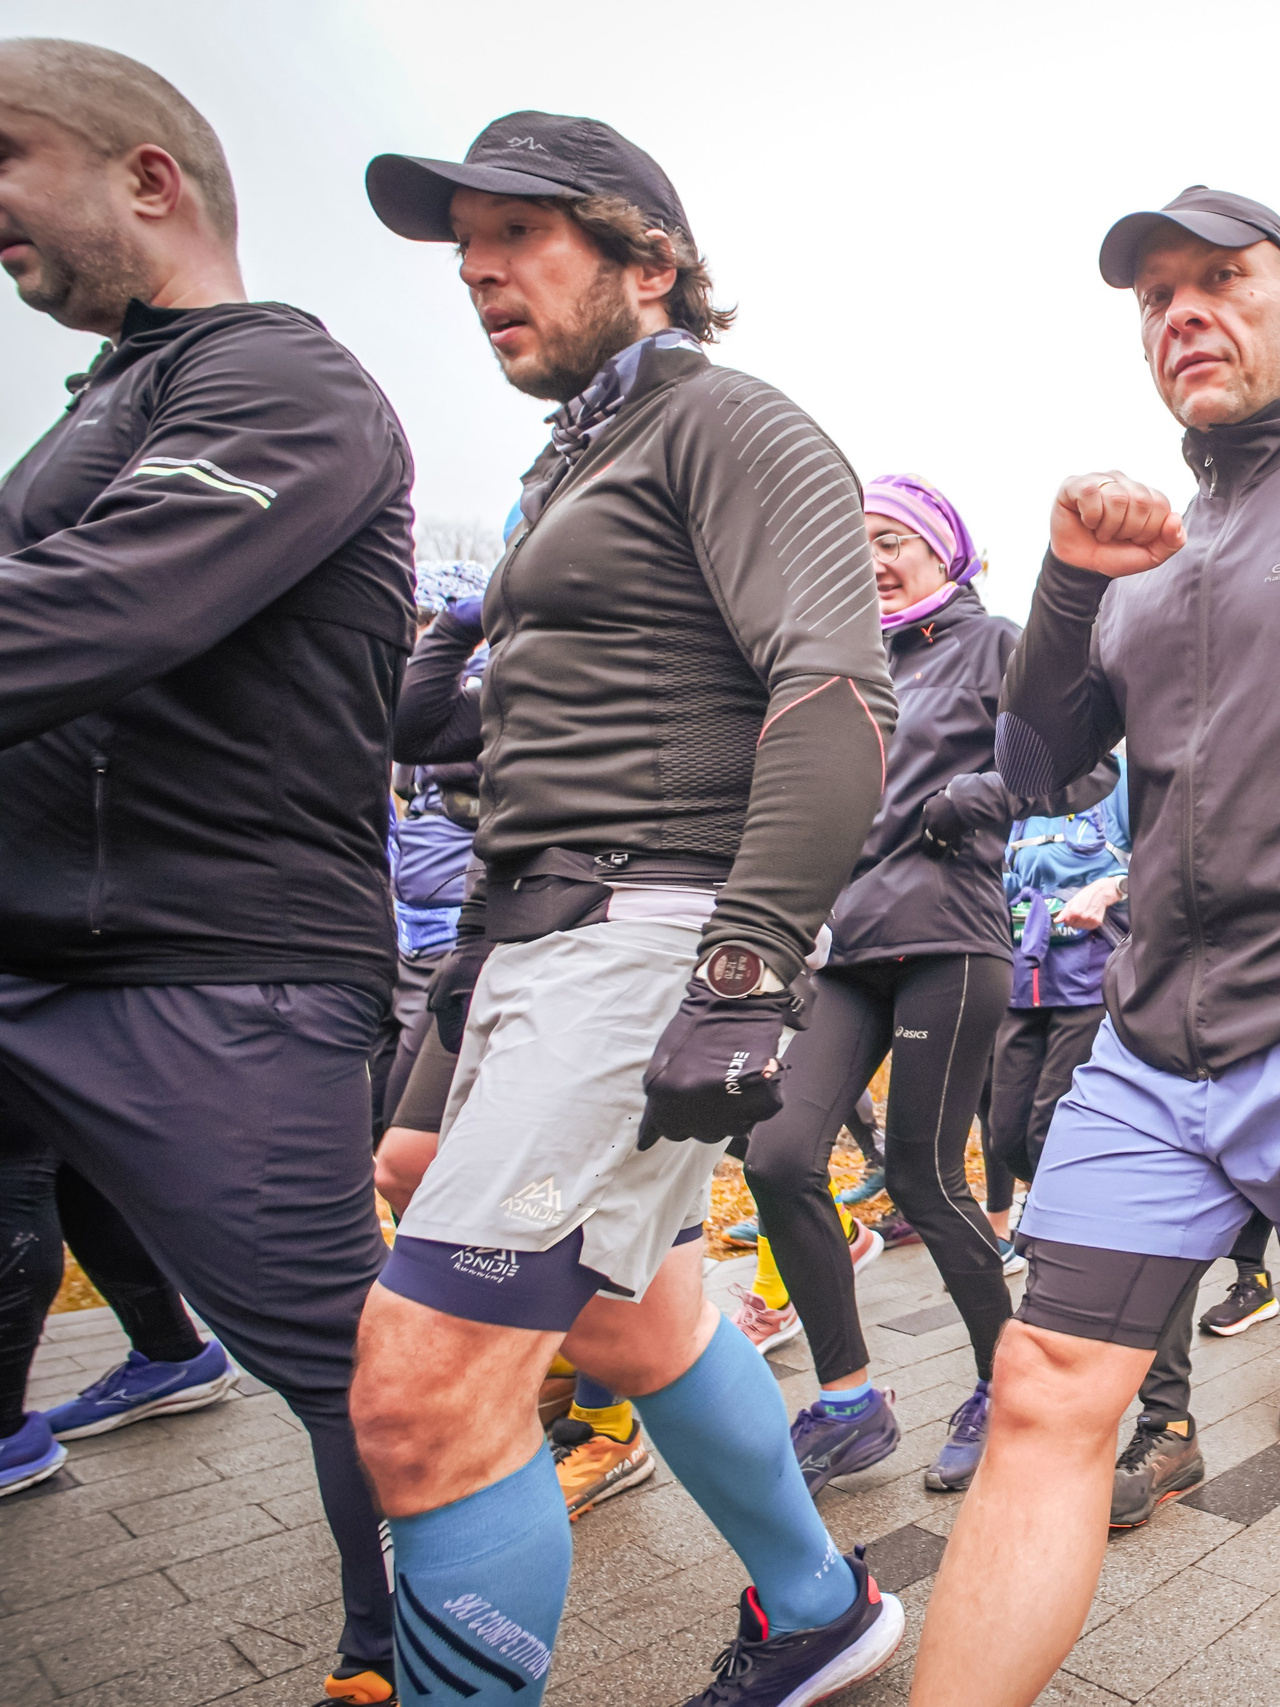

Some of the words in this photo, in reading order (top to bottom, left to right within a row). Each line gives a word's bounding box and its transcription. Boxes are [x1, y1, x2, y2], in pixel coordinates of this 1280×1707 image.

[902, 1029, 929, 1040] asics
[450, 1249, 521, 1278] AONIJIE
[442, 1592, 492, 1621] SKI
